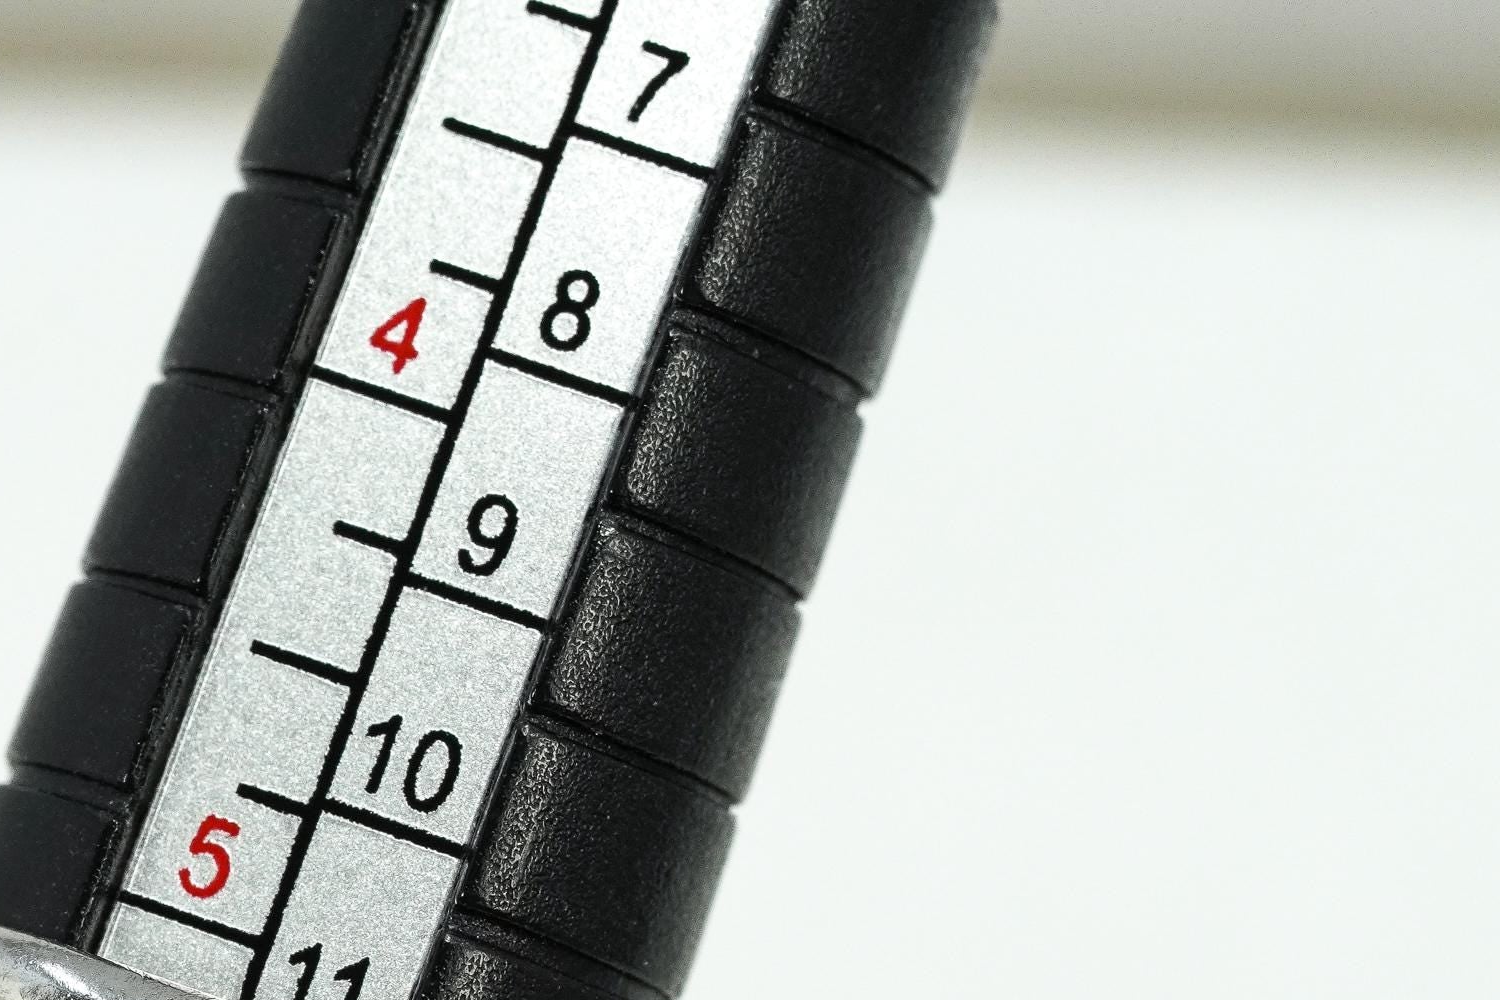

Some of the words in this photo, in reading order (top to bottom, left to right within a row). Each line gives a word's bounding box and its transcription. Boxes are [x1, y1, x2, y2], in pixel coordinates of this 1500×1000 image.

[628, 41, 690, 122] 7
[370, 297, 427, 374] 4
[540, 270, 600, 351] 8
[457, 494, 519, 576] 9
[364, 714, 462, 814] 10
[178, 814, 241, 900] 5
